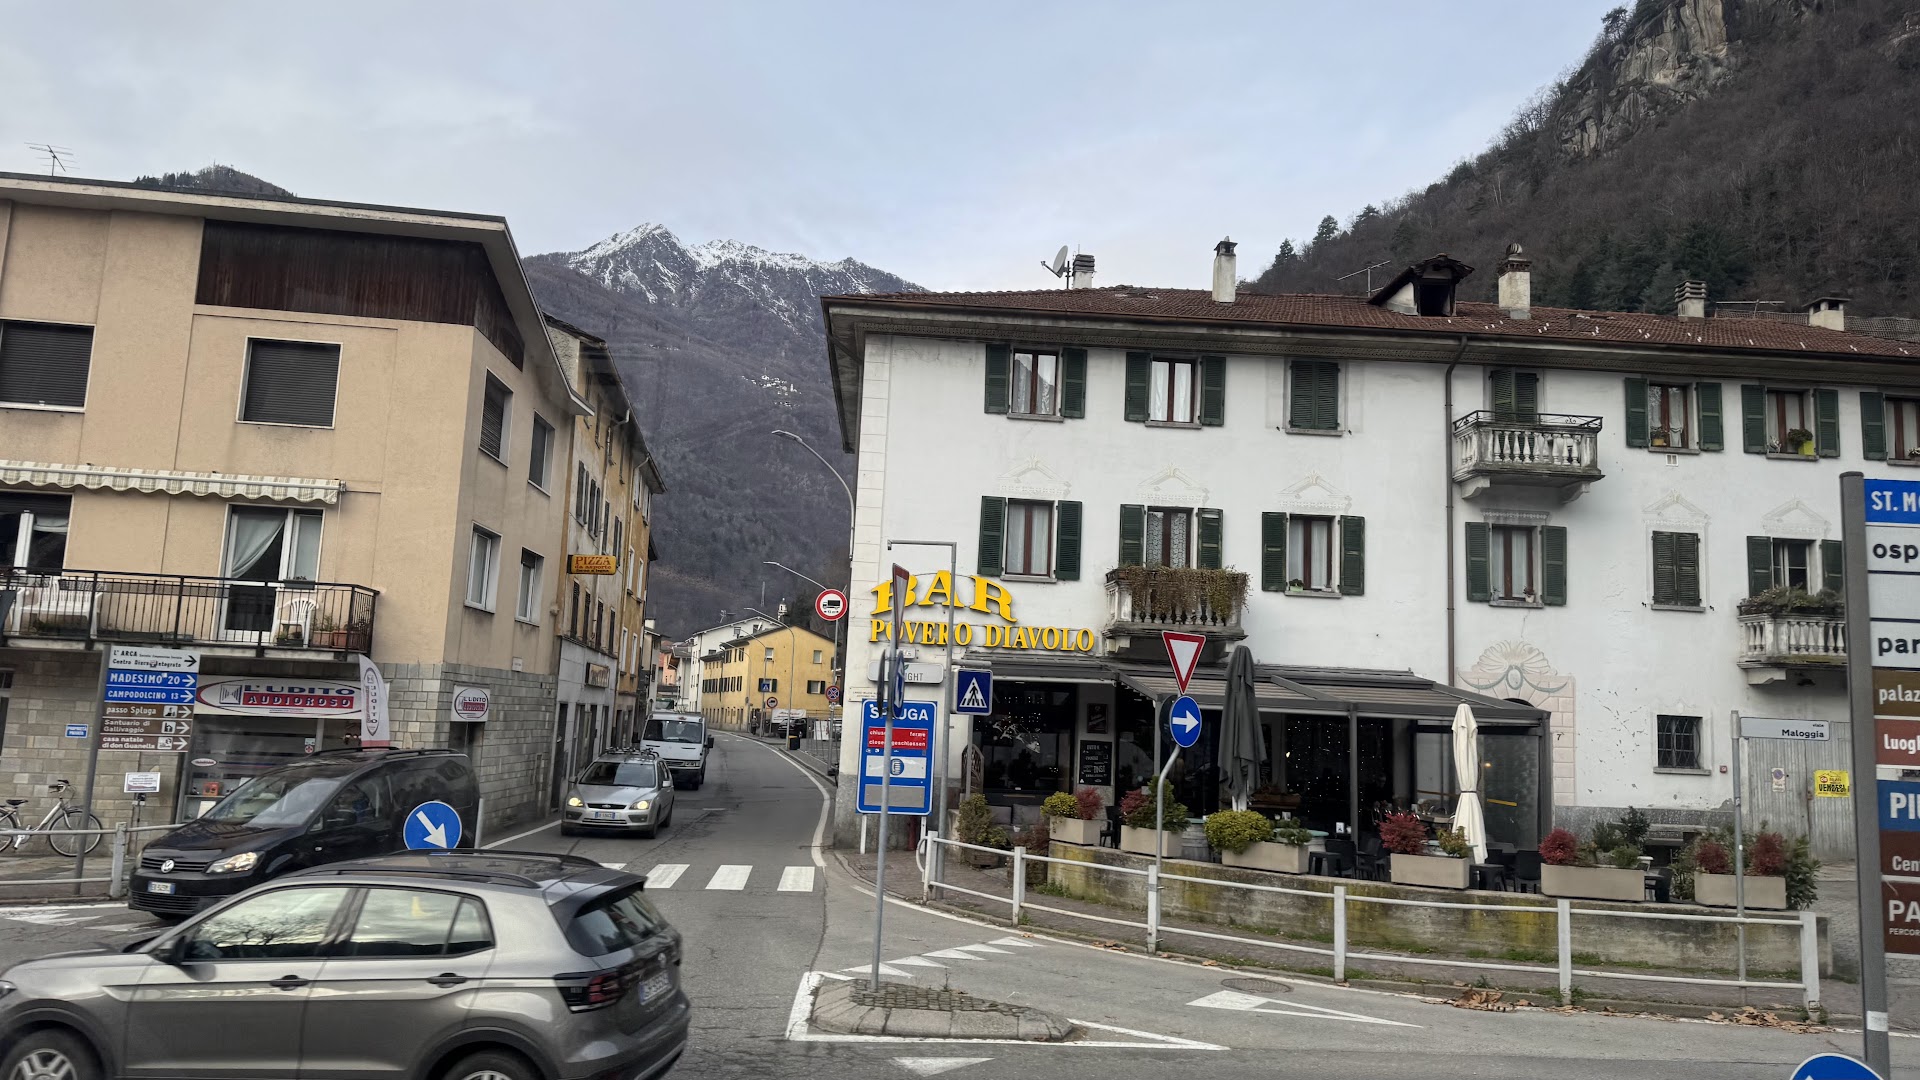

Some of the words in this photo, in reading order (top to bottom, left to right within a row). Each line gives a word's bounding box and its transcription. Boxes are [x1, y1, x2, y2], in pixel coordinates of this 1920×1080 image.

[1871, 491, 1898, 511] ST.
[1903, 492, 1920, 512] M
[575, 557, 611, 565] PIZZA
[870, 570, 1018, 623] BAR
[984, 624, 1095, 652] DIAVOLO
[110, 673, 162, 684] MADESIMO
[167, 675, 180, 685] 20
[108, 690, 166, 699] CAMPODOLCINO
[171, 692, 179, 700] 13
[244, 684, 355, 696] L'UDITO
[248, 695, 351, 708] AUDIOROSO
[130, 706, 157, 716] Spluga
[1782, 729, 1824, 738] Maloggia
[1890, 792, 1920, 819] PI
[1892, 855, 1920, 871] Cen
